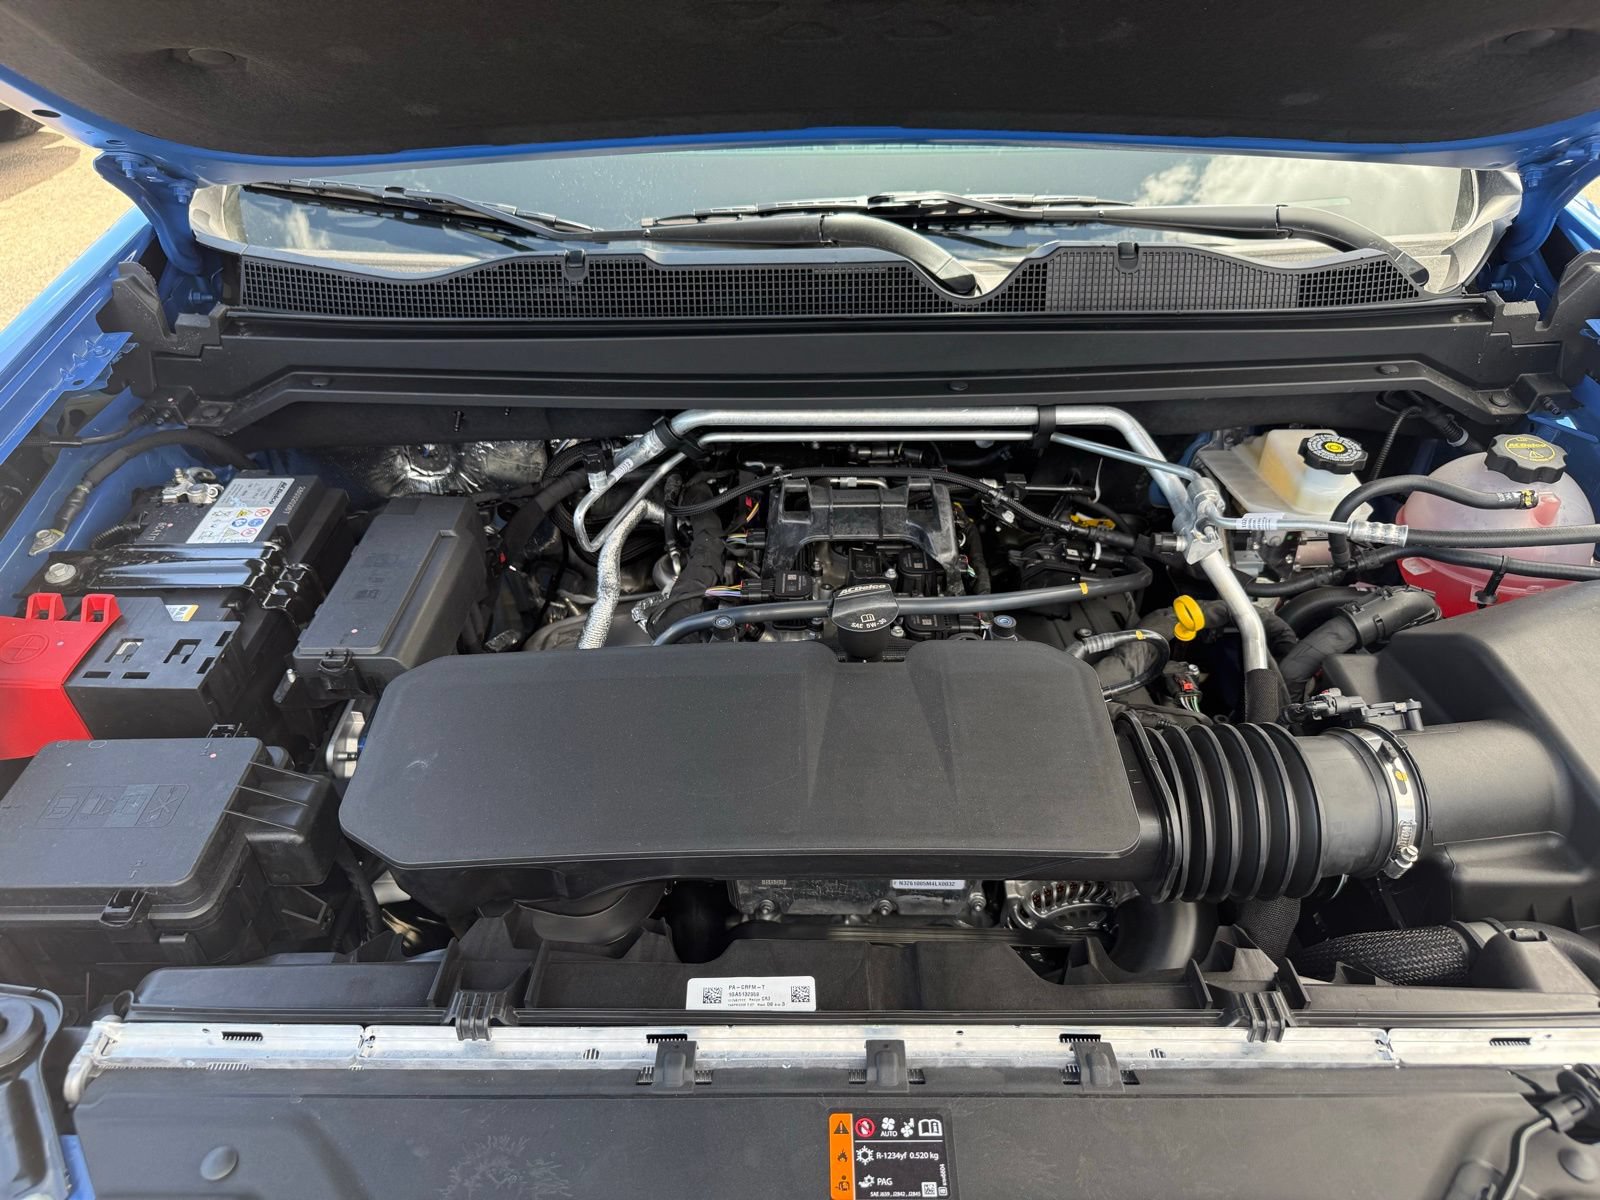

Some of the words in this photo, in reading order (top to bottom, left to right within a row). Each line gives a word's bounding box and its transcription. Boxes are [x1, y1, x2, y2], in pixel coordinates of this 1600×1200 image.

[838, 584, 886, 597] ACDelco
[866, 618, 887, 628] 5W-30
[880, 1130, 898, 1138] AUTO
[876, 1151, 907, 1161] R-1234yf
[909, 1152, 928, 1160] 0.520
[930, 1151, 939, 1161] kg
[877, 1177, 893, 1186] PAG
